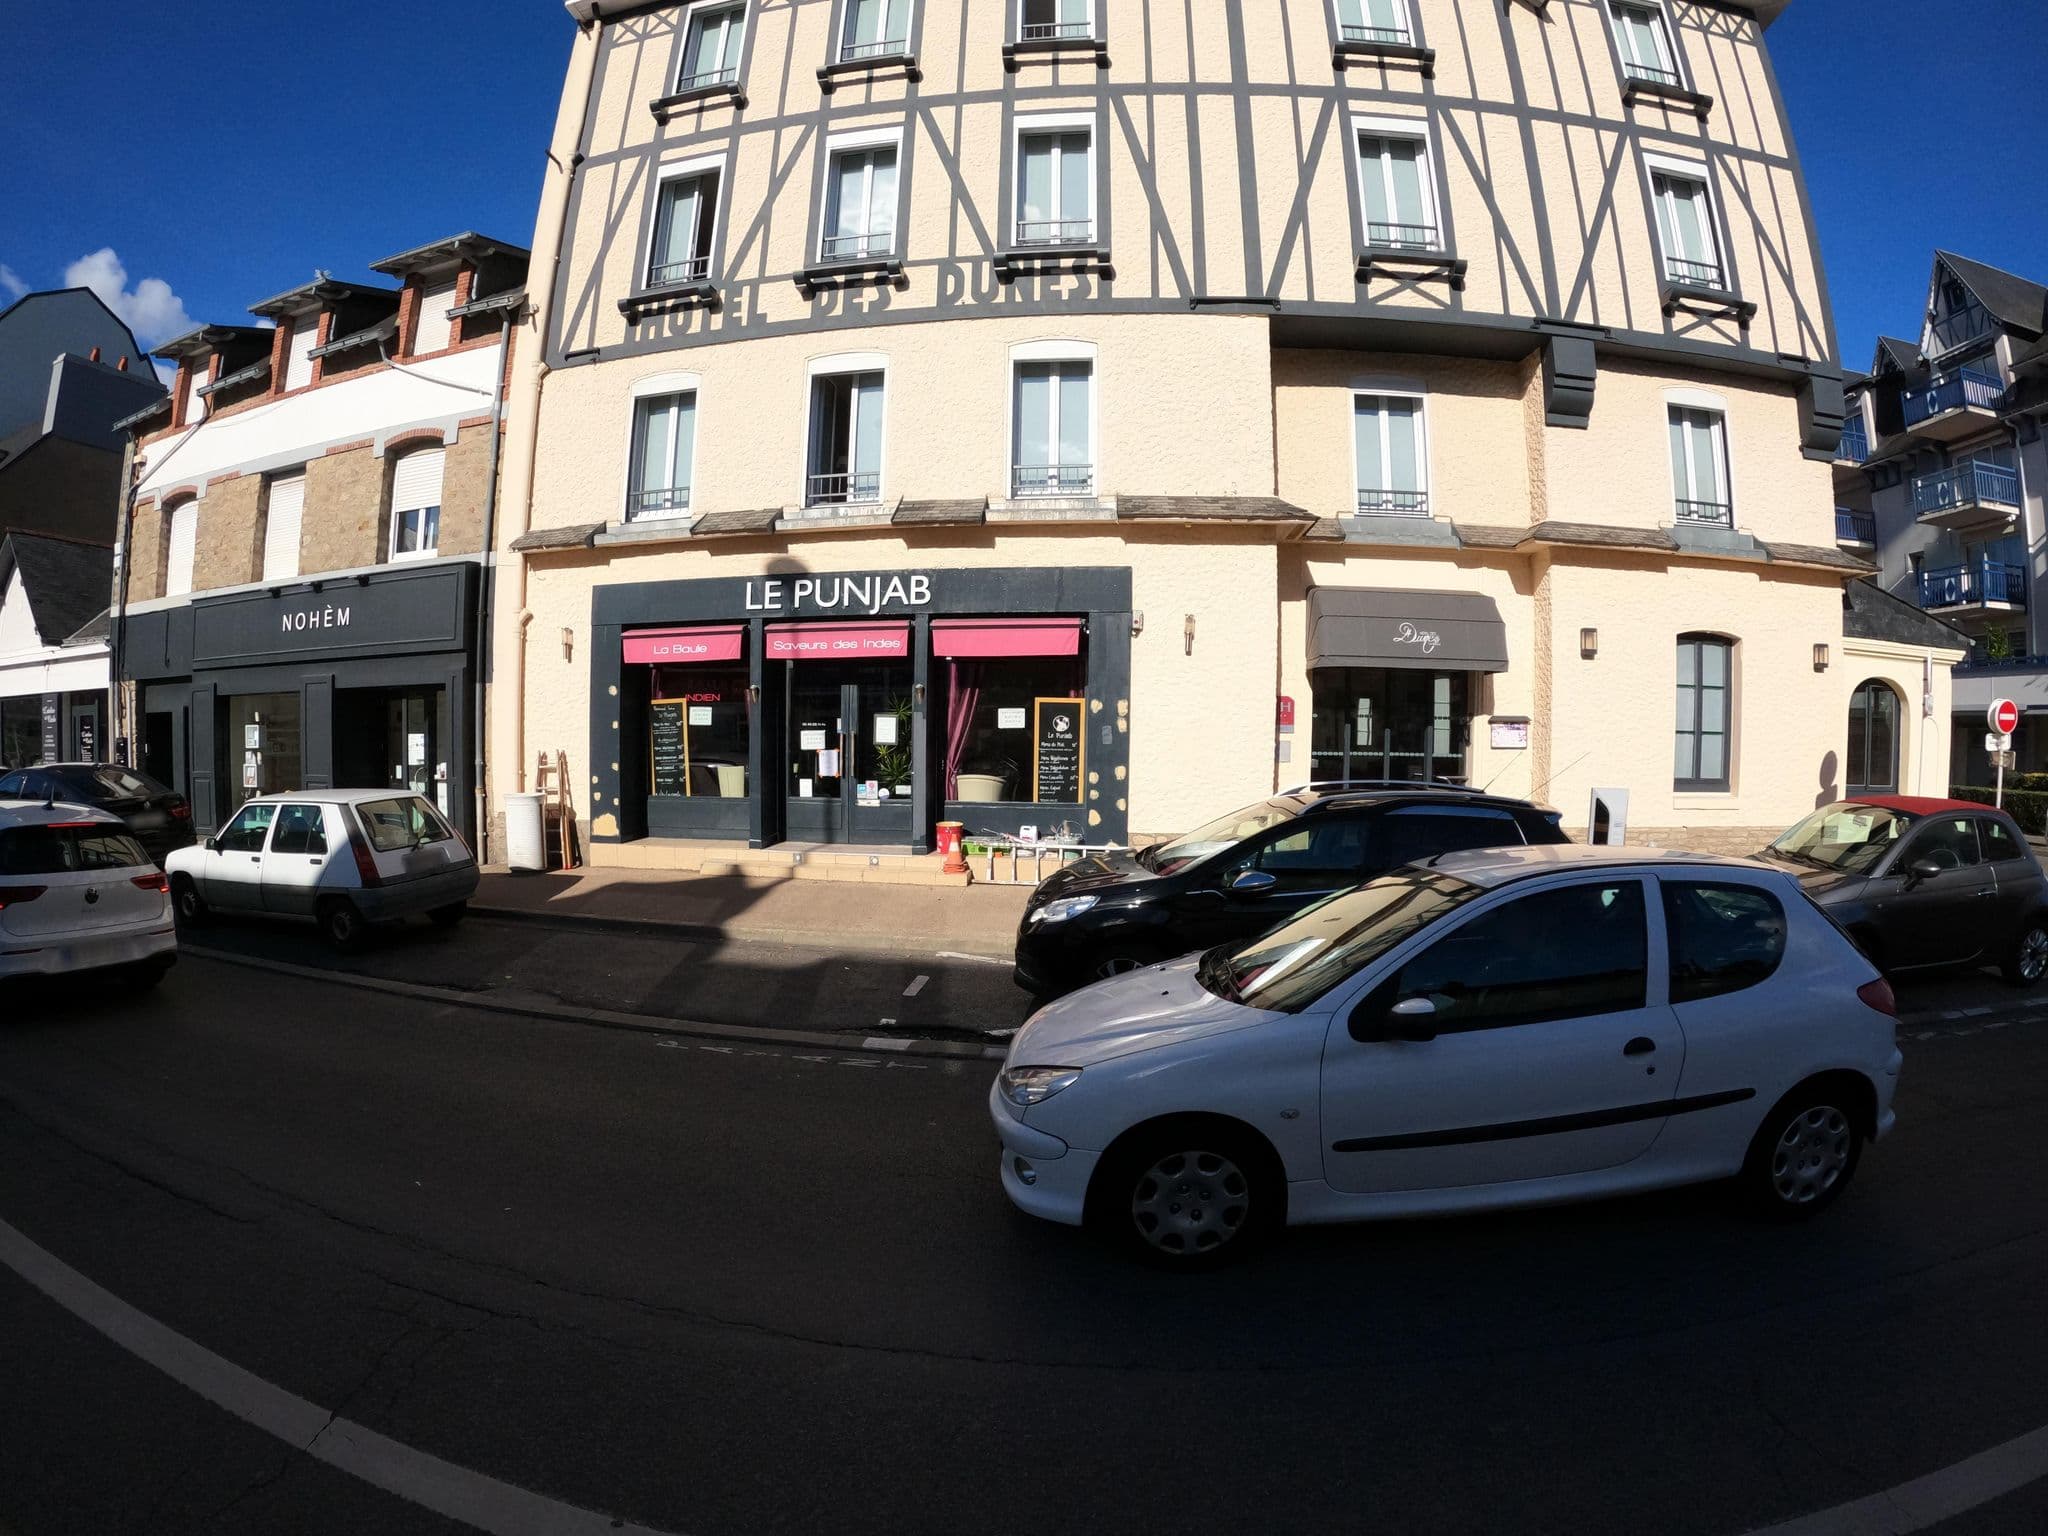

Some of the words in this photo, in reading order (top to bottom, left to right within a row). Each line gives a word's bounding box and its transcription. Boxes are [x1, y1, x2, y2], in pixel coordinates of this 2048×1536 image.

[745, 580, 784, 610] LE
[794, 575, 932, 615] PUNJAB
[282, 604, 350, 632] NOHÈM
[653, 645, 669, 655] La
[672, 643, 708, 654] Baule
[773, 640, 828, 651] Saveurs
[832, 639, 858, 649] des
[863, 638, 901, 649] Indes
[685, 693, 720, 702] INDIEN
